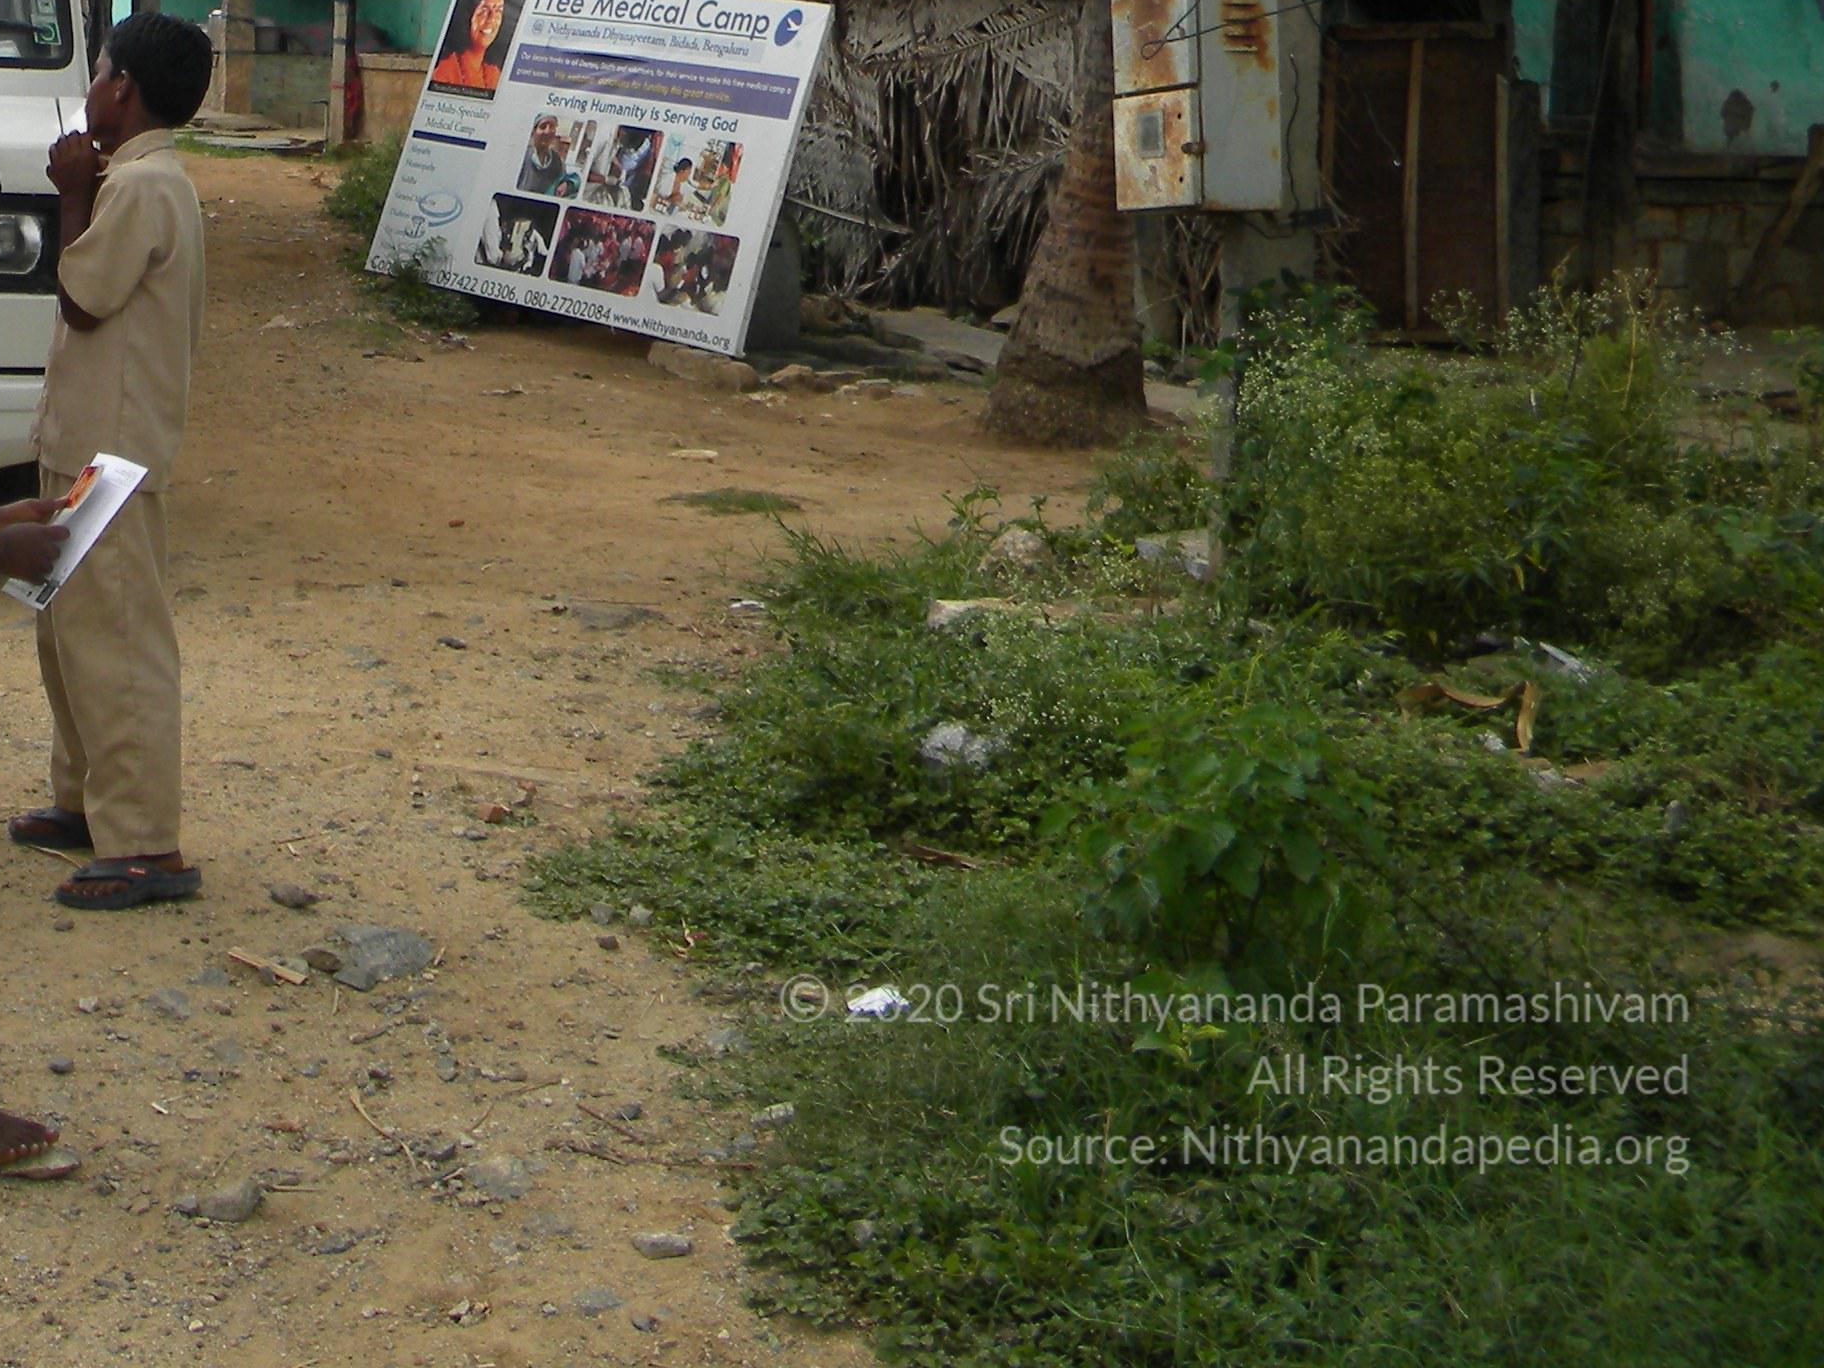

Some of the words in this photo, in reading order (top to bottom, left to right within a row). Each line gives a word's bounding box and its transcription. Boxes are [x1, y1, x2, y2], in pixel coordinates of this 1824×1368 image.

[696, 0, 770, 40] Camp
[703, 40, 750, 58] Bengaluru
[546, 92, 588, 113] Serving
[590, 98, 647, 122] Humanity
[650, 106, 660, 120] is
[662, 108, 708, 129] Serving
[711, 116, 739, 133] God
[480, 279, 520, 305] 03306,
[524, 289, 614, 324] 080-27202084
[612, 309, 732, 349] www.Nithyananda.org
